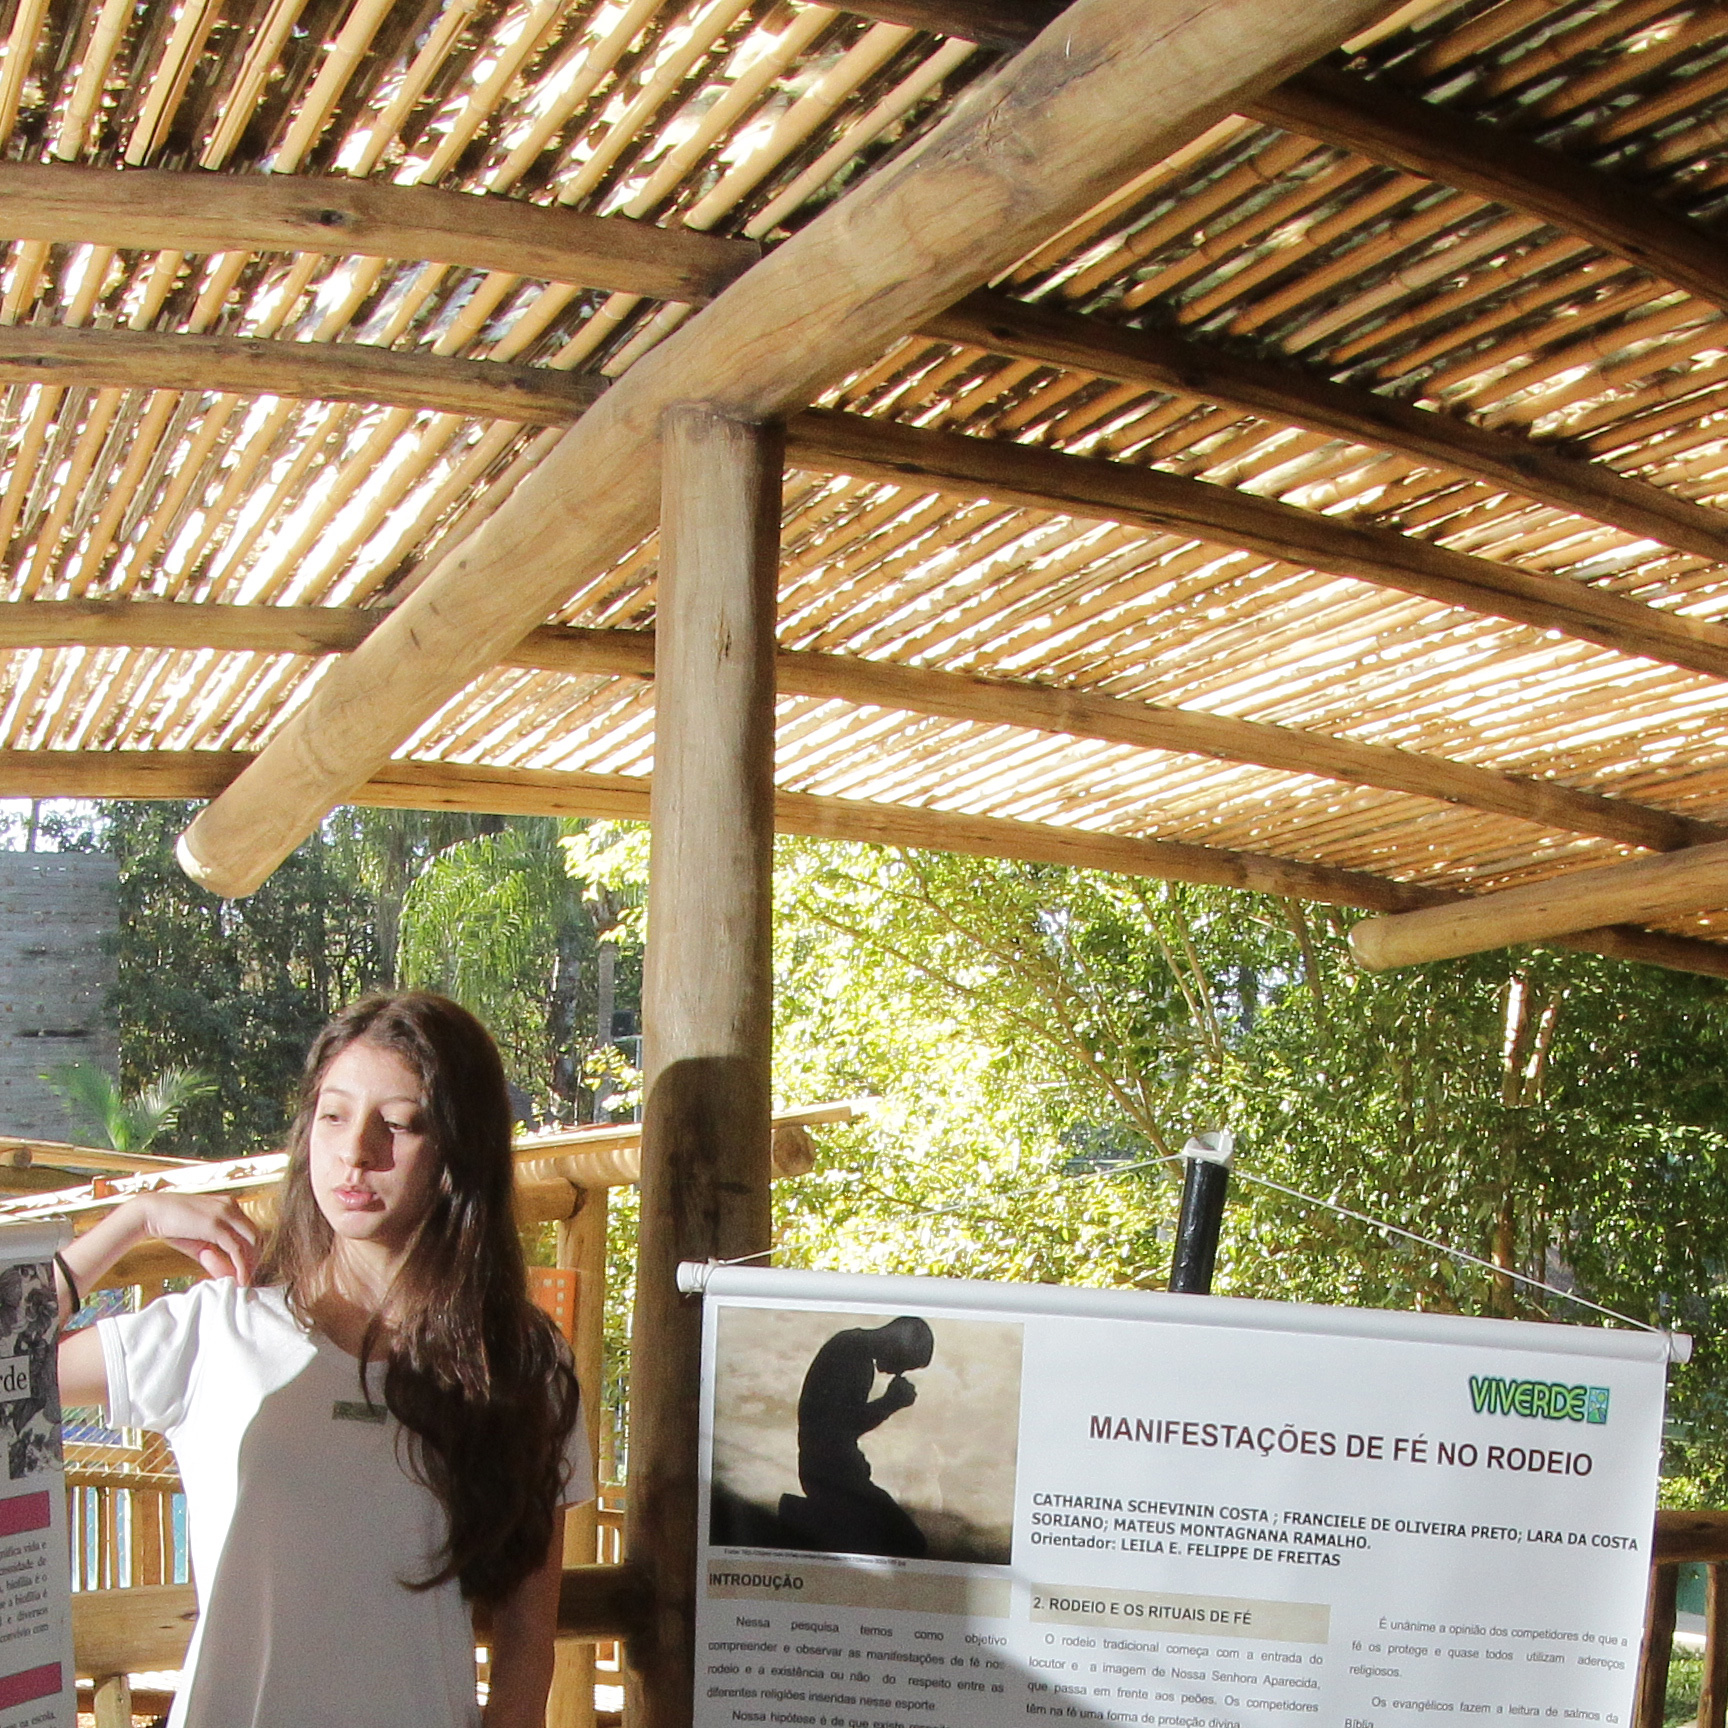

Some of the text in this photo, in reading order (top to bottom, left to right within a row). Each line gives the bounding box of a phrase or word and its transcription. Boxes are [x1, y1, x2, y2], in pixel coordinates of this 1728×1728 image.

[1469, 1376, 1588, 1421] VIVERDE
[1090, 1415, 1592, 1476] MANIFESTAÇÕES DE FÉ NO RODEIO
[1031, 1512, 1371, 1549] SORIANO; MATEUS MONTAGNANA RAMALHO.
[1032, 1492, 1123, 1511] CATHARINA
[1127, 1499, 1214, 1518] SCHEVININ
[1219, 1506, 1268, 1522] COSTA
[1283, 1511, 1366, 1530] FRANCIELE
[1370, 1517, 1391, 1531] DE
[1394, 1519, 1466, 1537] OLIVEIRA
[1470, 1525, 1522, 1543] PRETO;
[1526, 1529, 1563, 1544] LARA
[1567, 1532, 1587, 1546] DA
[1591, 1534, 1638, 1551] COSTA
[1030, 1531, 1341, 1567] Orientador: LEILA E. FELIPPE DE FREITAS
[708, 1572, 804, 1591] INTRODUÇÃO
[1049, 1597, 1106, 1614] RODEIO
[1109, 1602, 1119, 1615] E
[1123, 1603, 1144, 1617] OS
[1148, 1605, 1205, 1622] RITUAIS
[1209, 1609, 1230, 1624] DE
[1233, 1609, 1252, 1625] FÉ
[1044, 1632, 1324, 1669] O rodeio tradicional começa com a entrada do
[1026, 1655, 1321, 1691] locutor e a imagem de Nossa Senhora Aparecida,
[1025, 1702, 1047, 1714] têm
[1049, 1707, 1063, 1717] na
[1066, 1706, 1078, 1717] fé
[1078, 1708, 1105, 1721] uma
[1105, 1709, 1138, 1724] forma
[1140, 1712, 1156, 1724] de
[1157, 1715, 1206, 1728] proteção
[1026, 1681, 1319, 1713] que passa em frente aos peões. Os competidores
